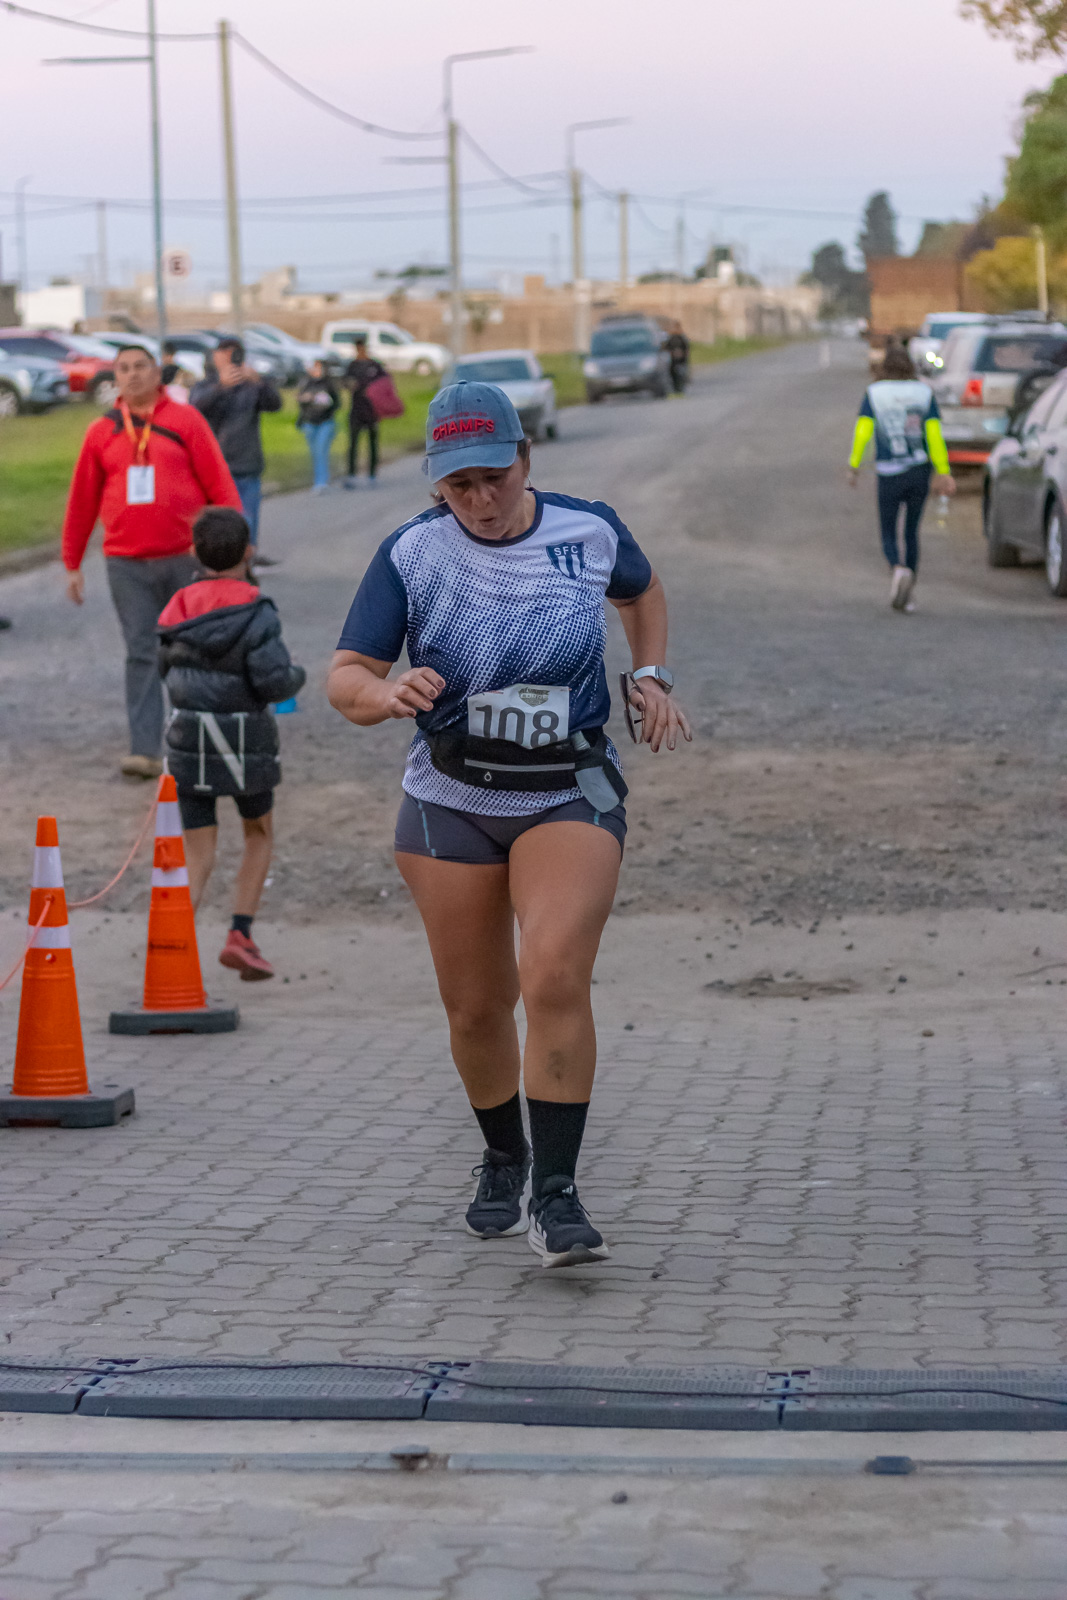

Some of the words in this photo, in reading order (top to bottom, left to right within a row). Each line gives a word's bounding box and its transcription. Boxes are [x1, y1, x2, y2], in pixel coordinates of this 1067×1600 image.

[432, 418, 495, 441] CHAMPS
[553, 545, 579, 556] SFC
[475, 704, 560, 749] 108
[193, 711, 249, 791] N
